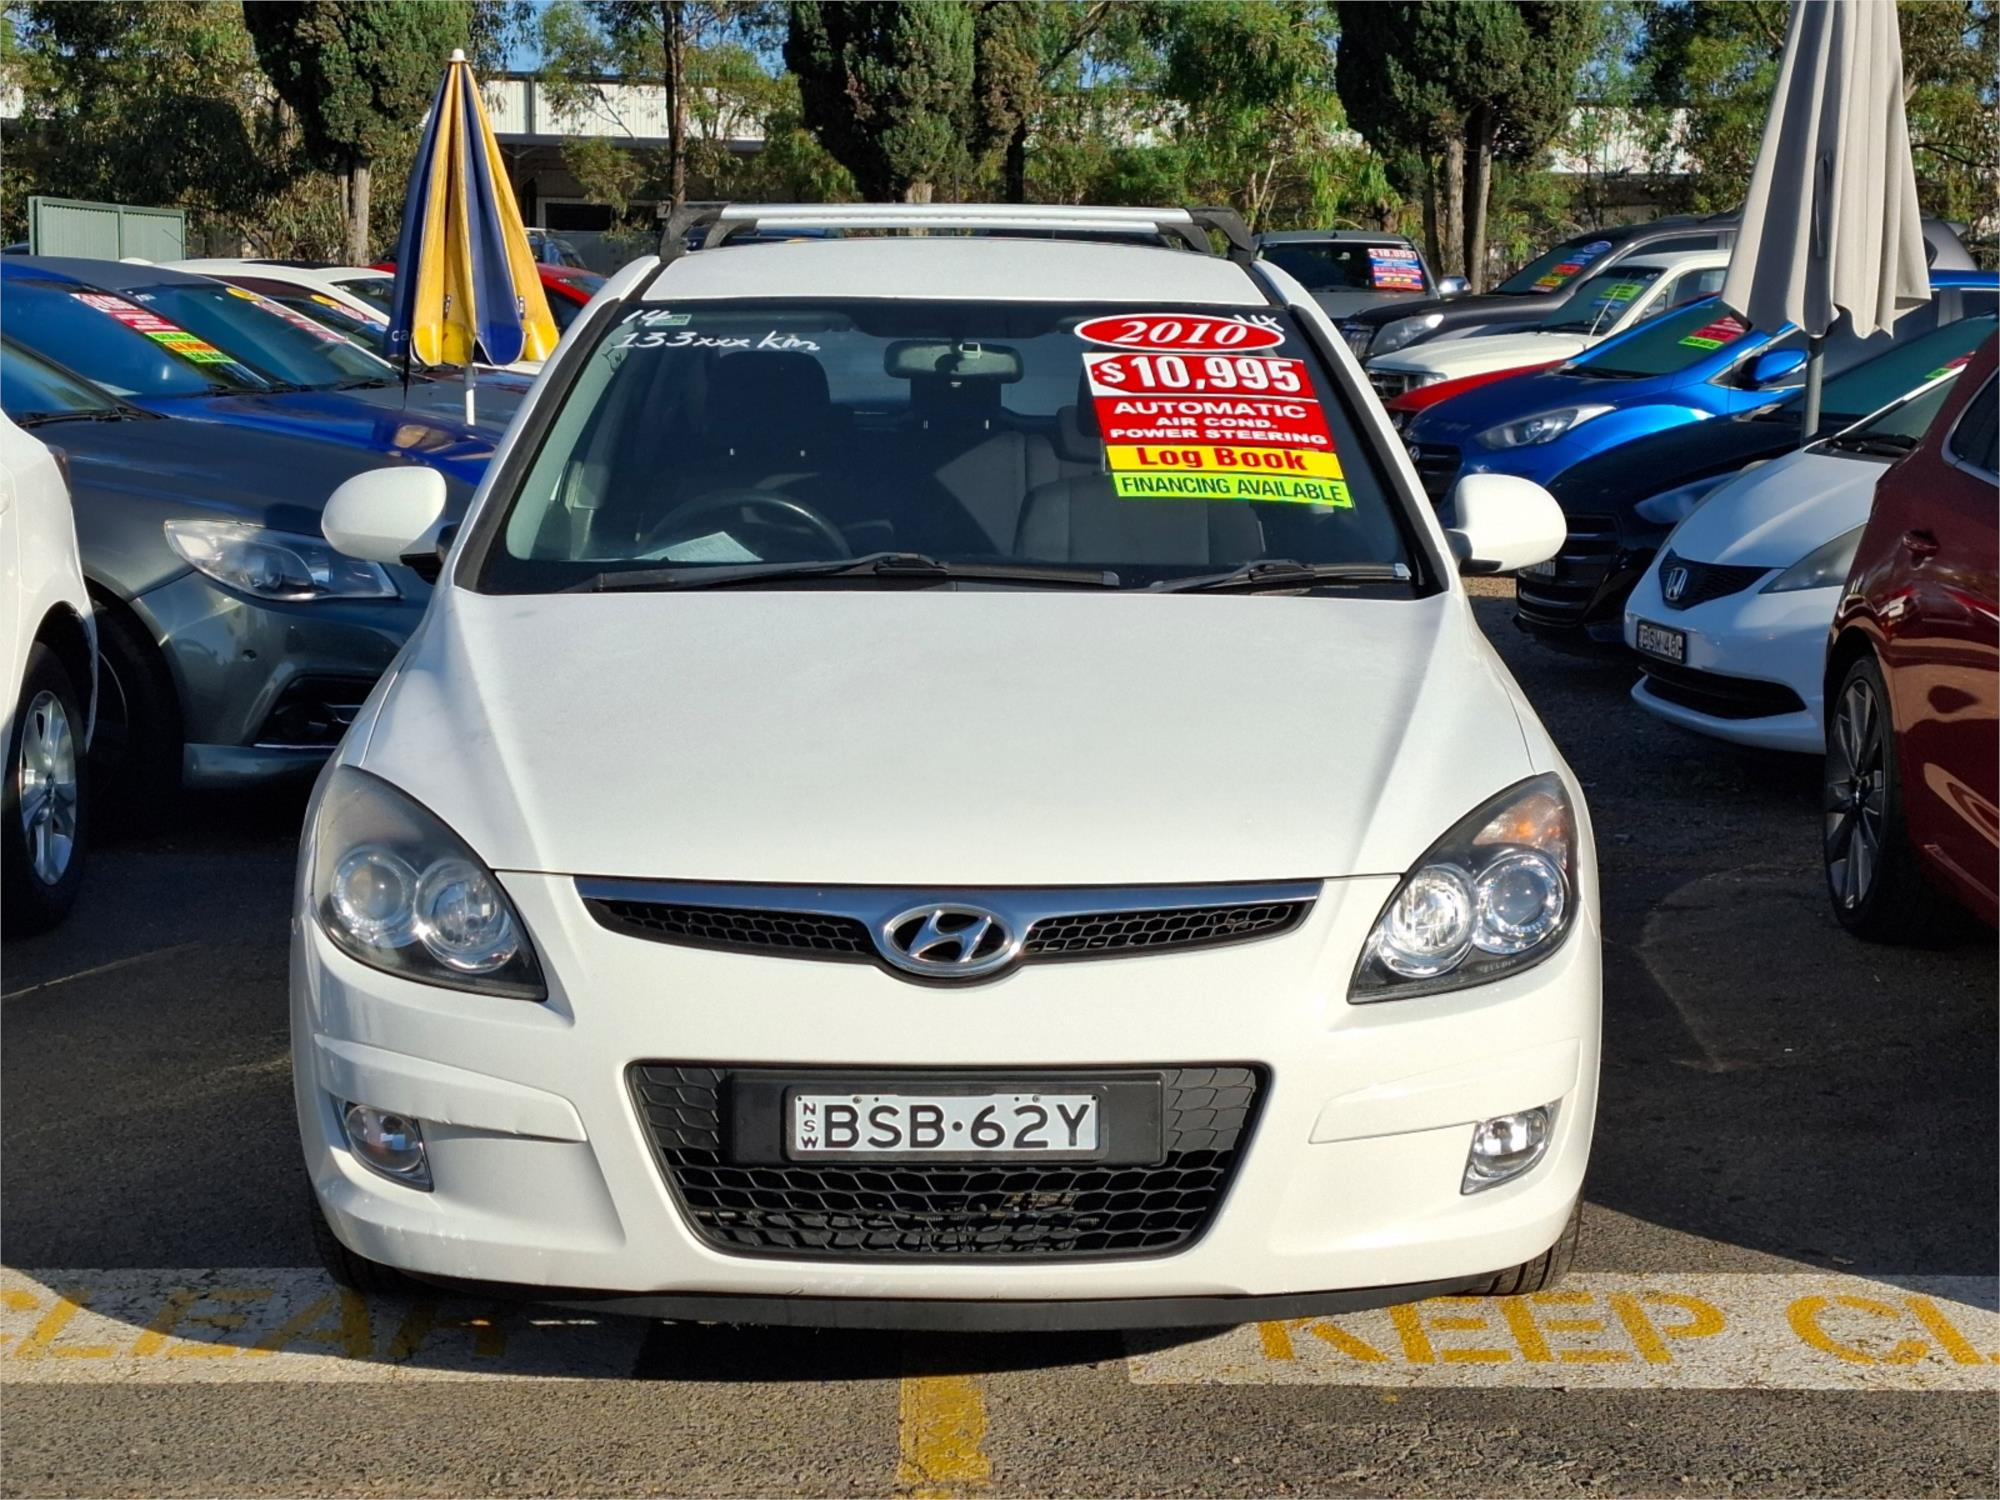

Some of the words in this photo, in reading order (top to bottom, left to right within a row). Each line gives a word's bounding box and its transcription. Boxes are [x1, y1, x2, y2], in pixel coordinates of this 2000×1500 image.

[1112, 320, 1249, 346] 2010
[1099, 355, 1301, 392] $10,995
[1113, 401, 1308, 419] AUTOMATIC
[1156, 416, 1197, 427] AIR
[1203, 417, 1278, 429] COND.
[1110, 428, 1199, 439] POWER
[1205, 429, 1329, 445] STEERING
[1136, 446, 1204, 469] Log
[1213, 447, 1308, 472] Book
[1121, 476, 1231, 495] FINANCING
[1237, 479, 1344, 502] AVAILABLE
[801, 1102, 819, 1149] NSW
[1256, 1290, 1725, 1364] KEEP
